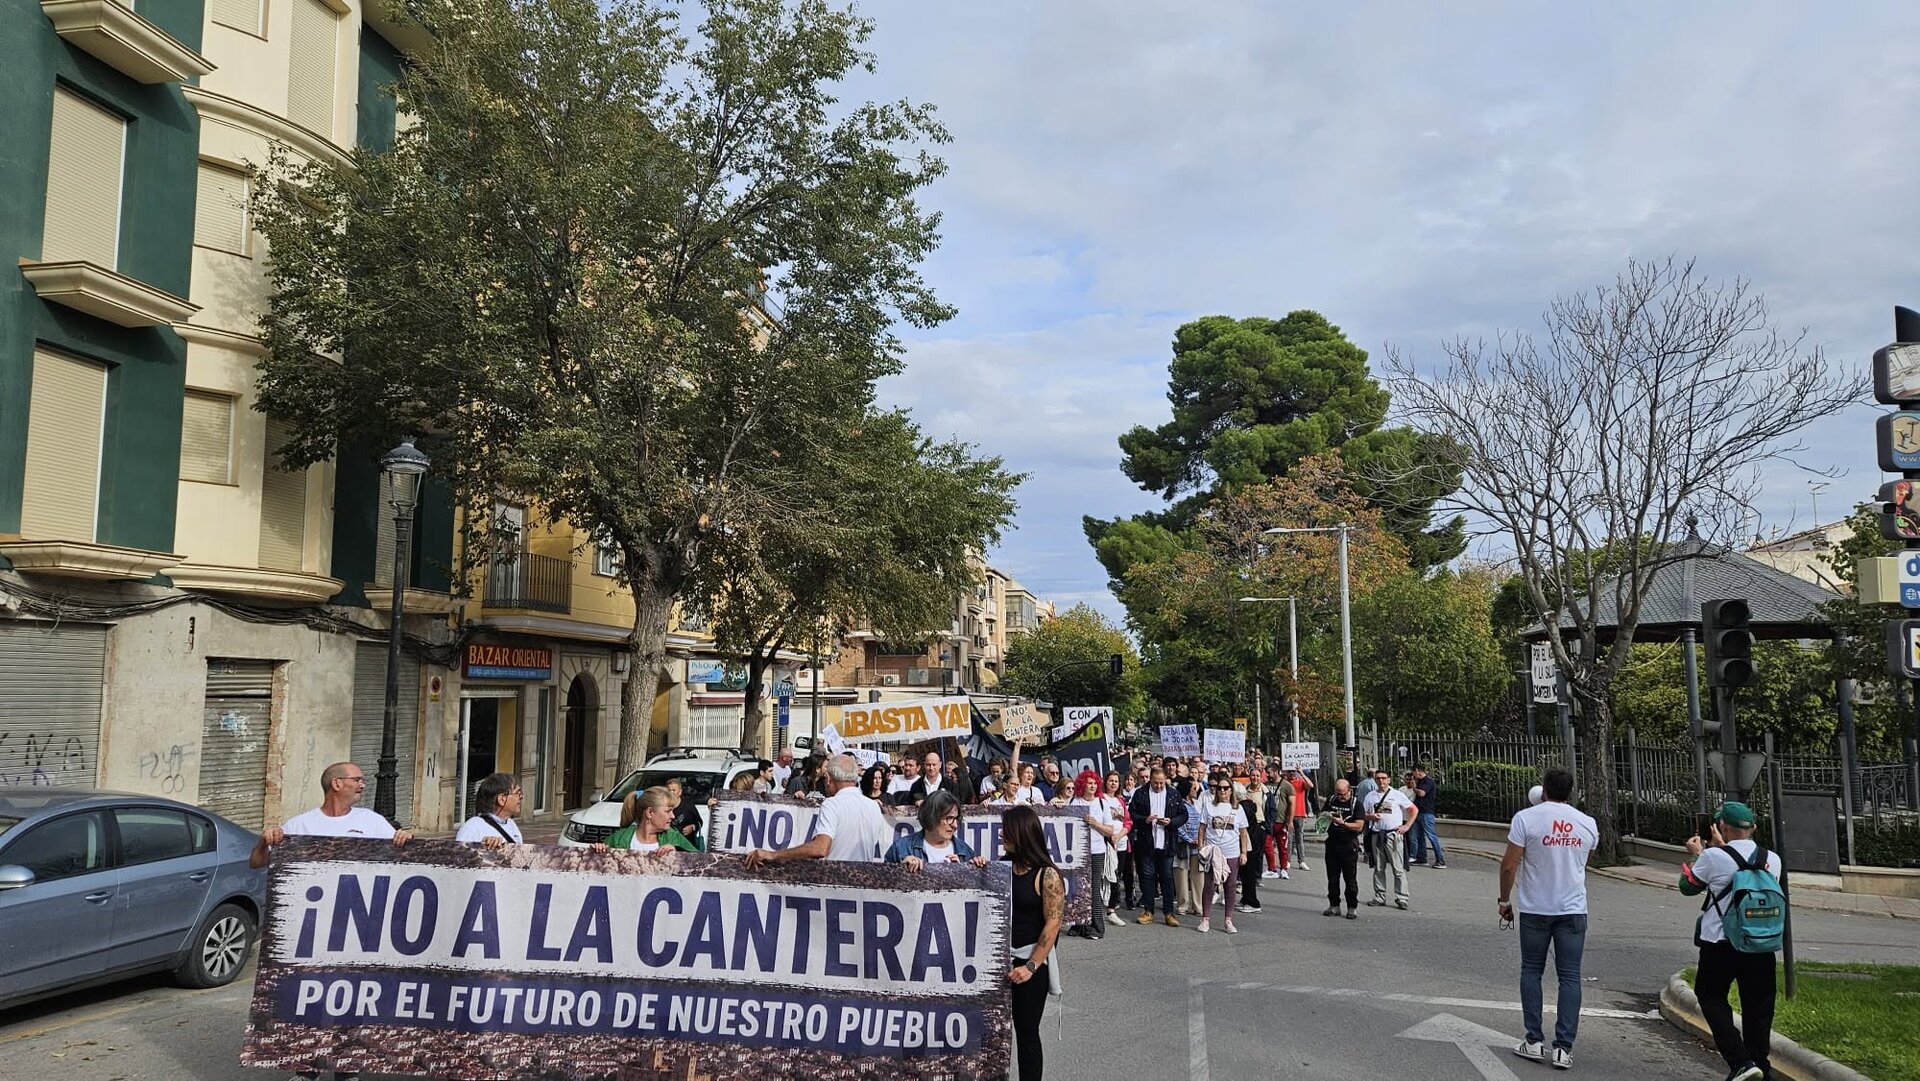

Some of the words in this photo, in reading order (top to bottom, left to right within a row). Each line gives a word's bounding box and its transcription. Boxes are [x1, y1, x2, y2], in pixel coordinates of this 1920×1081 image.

[468, 645, 509, 666] BAZAR
[512, 648, 551, 668] ORIENTAL
[844, 706, 929, 737] ¡BASTA
[933, 703, 969, 730] YA!
[1022, 716, 1033, 724] LA
[1069, 709, 1090, 720] CON
[1004, 724, 1040, 738] CANTERA
[724, 807, 794, 851] ¡NO
[1542, 835, 1582, 848] CANTERA
[295, 873, 439, 959] ¡NO
[451, 880, 501, 960] A
[526, 883, 614, 963] LA
[636, 886, 979, 985] CANTERA!
[295, 979, 381, 1017] POR
[395, 981, 434, 1020] EL
[447, 986, 602, 1027] FUTURO
[612, 992, 660, 1030] DE
[667, 995, 828, 1042] NUESTRO
[838, 1006, 968, 1048] PUEBLO
